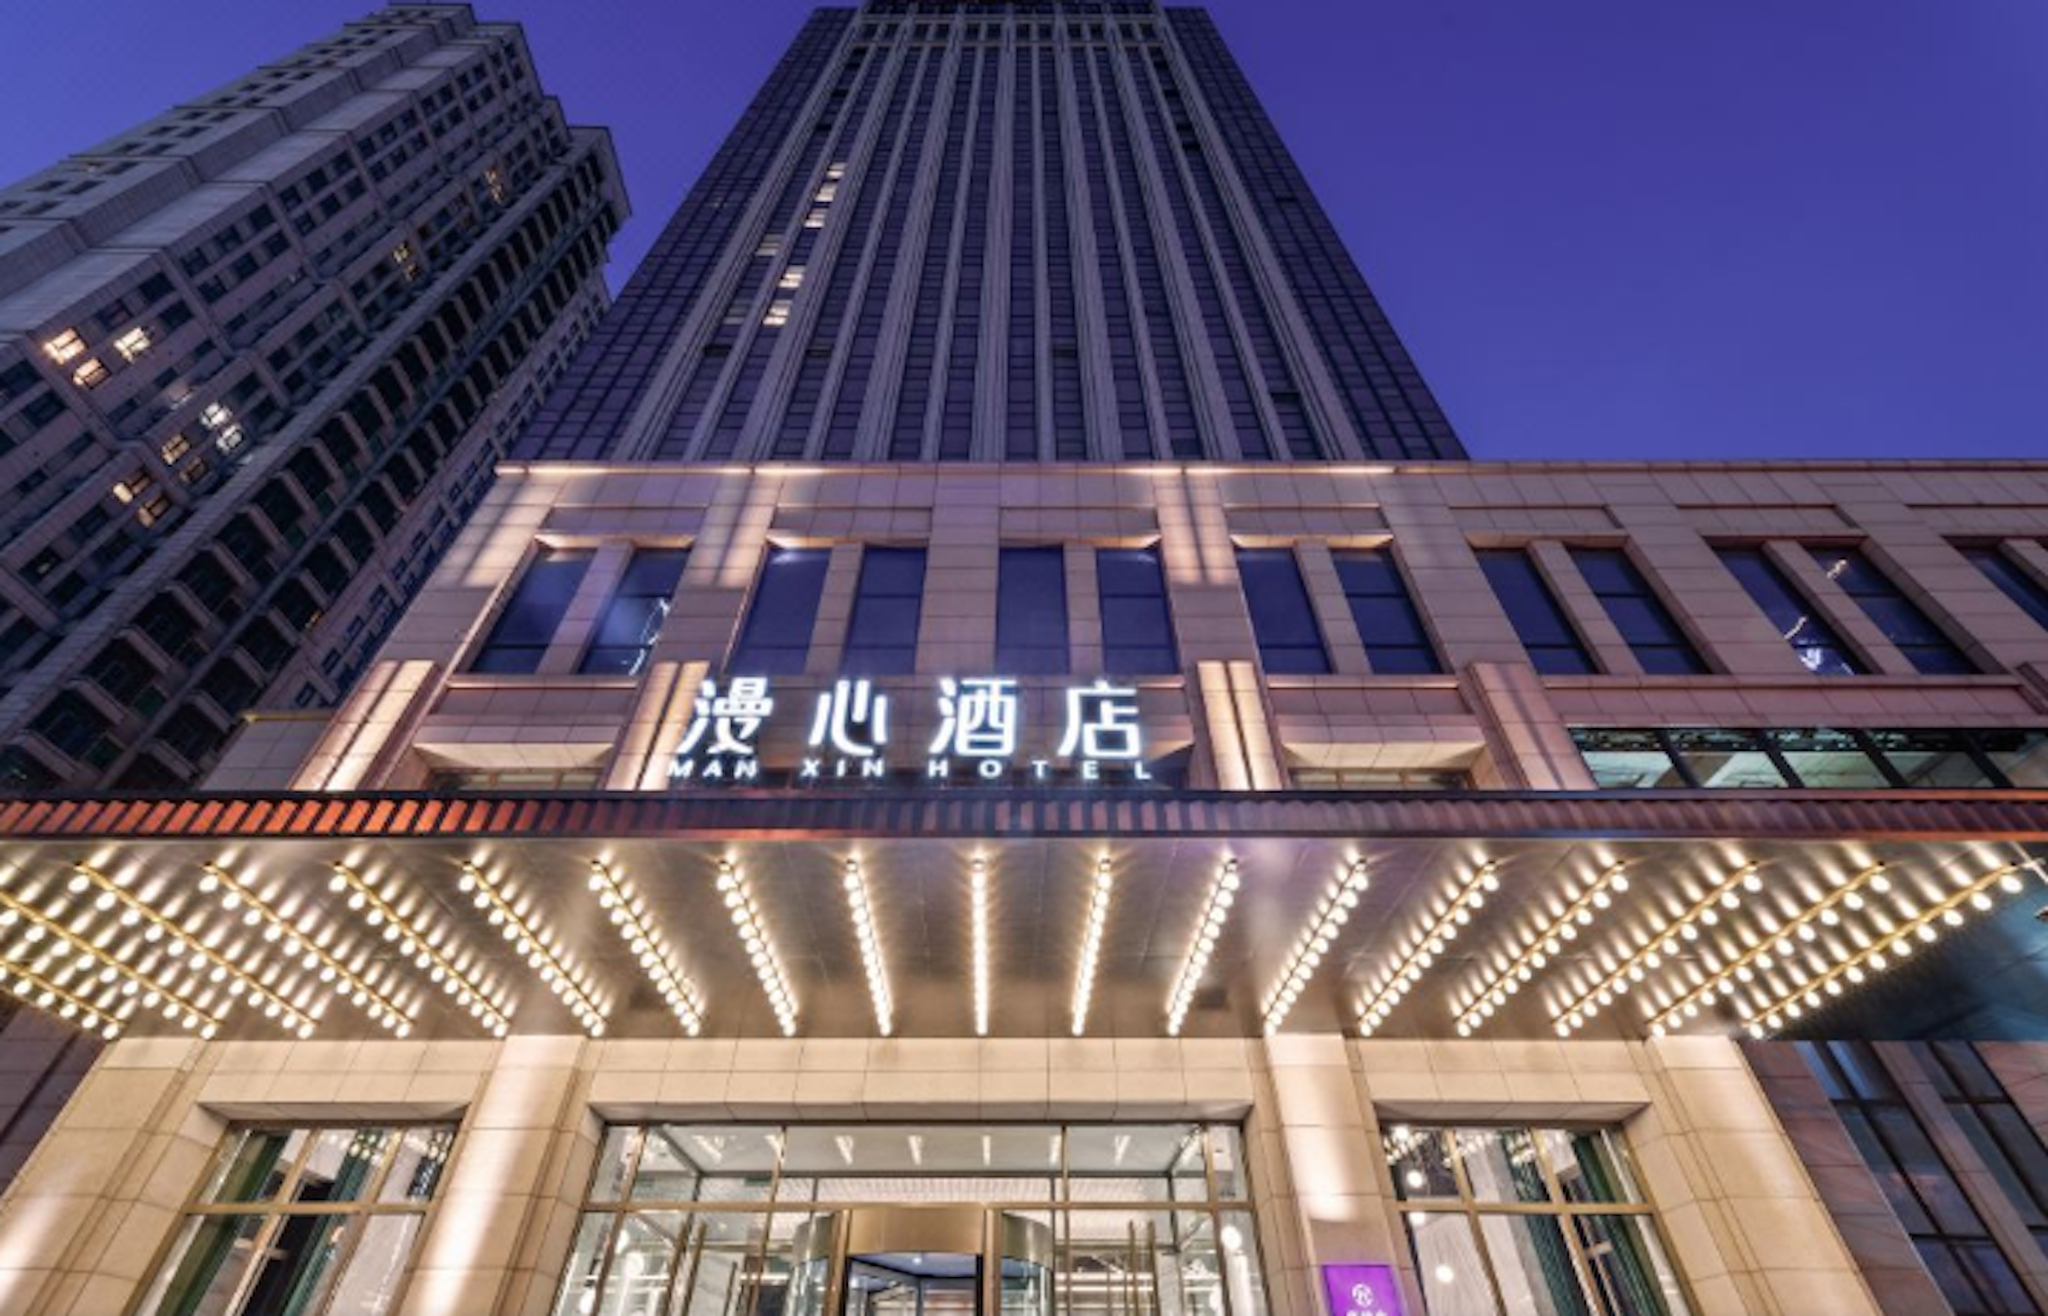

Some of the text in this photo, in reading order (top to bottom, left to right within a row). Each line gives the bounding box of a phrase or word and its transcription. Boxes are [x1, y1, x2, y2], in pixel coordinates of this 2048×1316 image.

[676, 676, 1142, 759] 漫心酒店
[667, 758, 1152, 781] MAN XIN HOTEL
